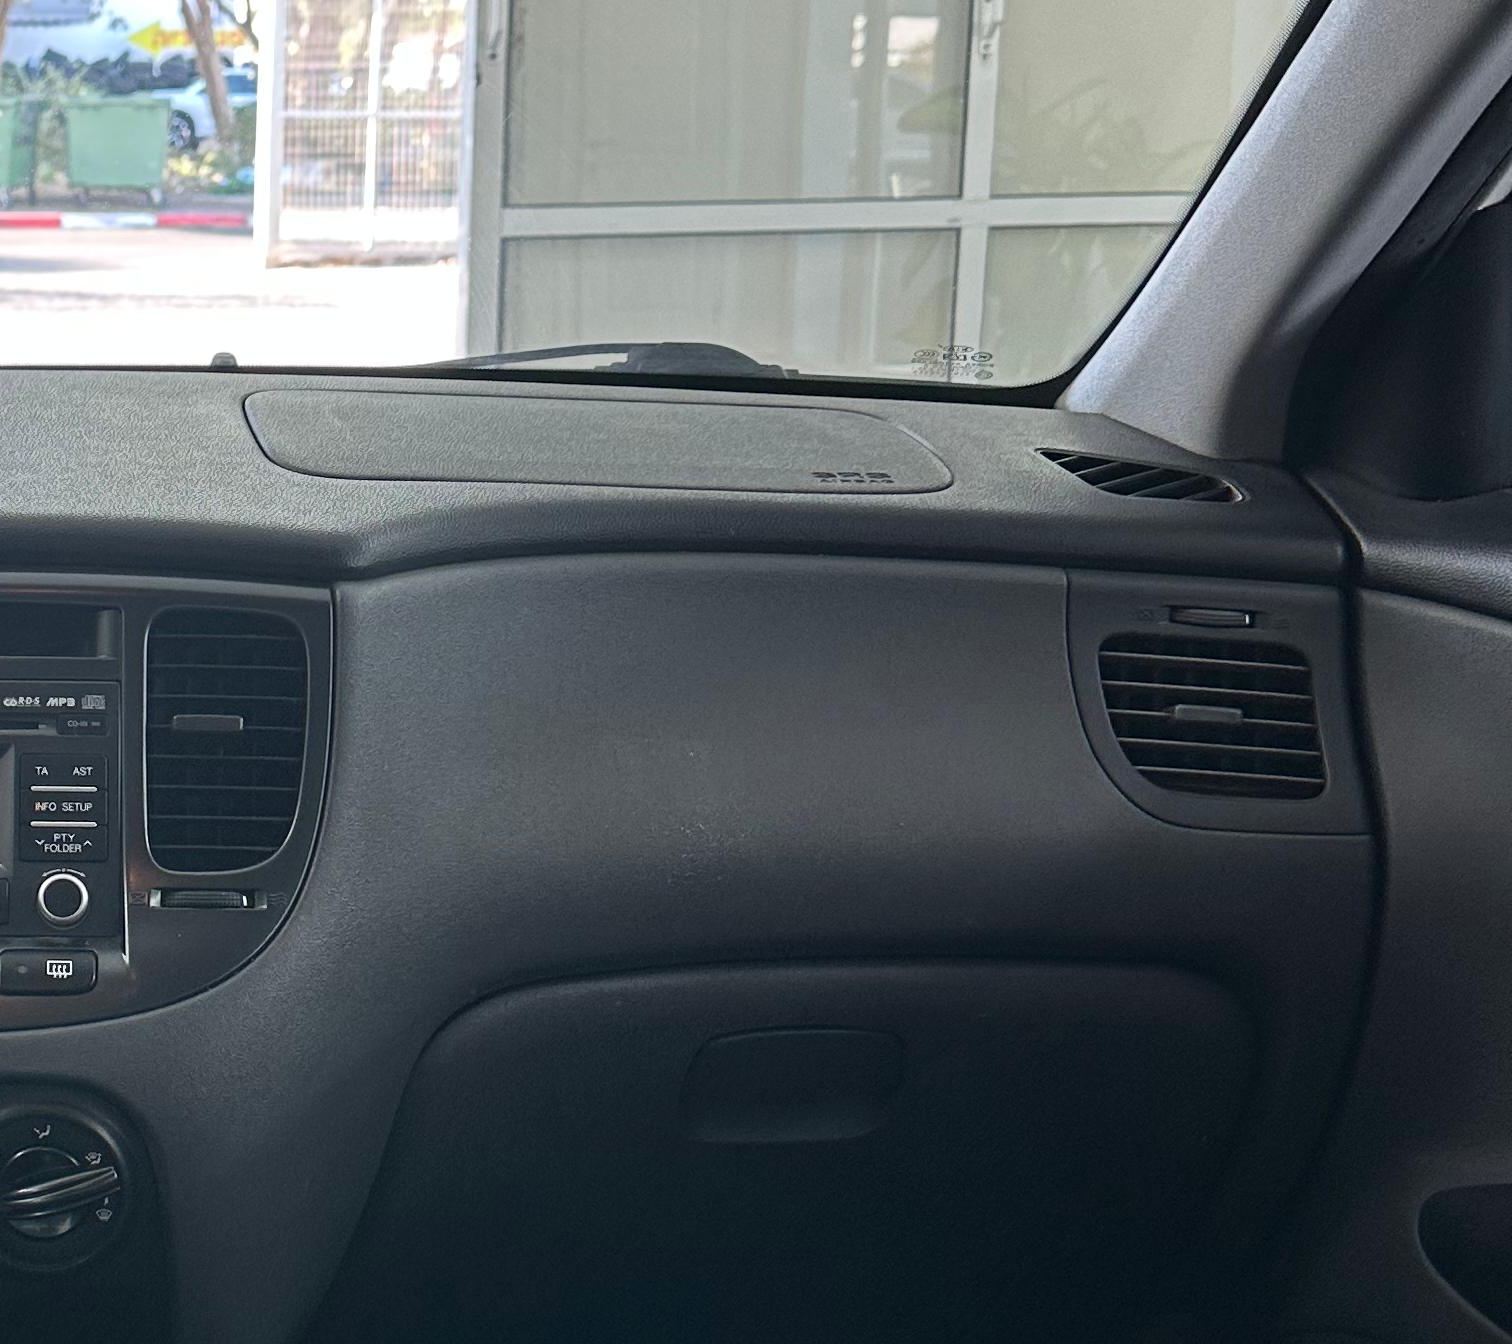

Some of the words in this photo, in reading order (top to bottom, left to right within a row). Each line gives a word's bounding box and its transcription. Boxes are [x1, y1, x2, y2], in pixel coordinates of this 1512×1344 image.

[35, 766, 48, 776] TA
[72, 766, 94, 776] AST
[34, 802, 56, 812] INFO
[62, 802, 93, 812] SETUP
[53, 833, 76, 842] PTY
[44, 844, 82, 853] FOLDER
